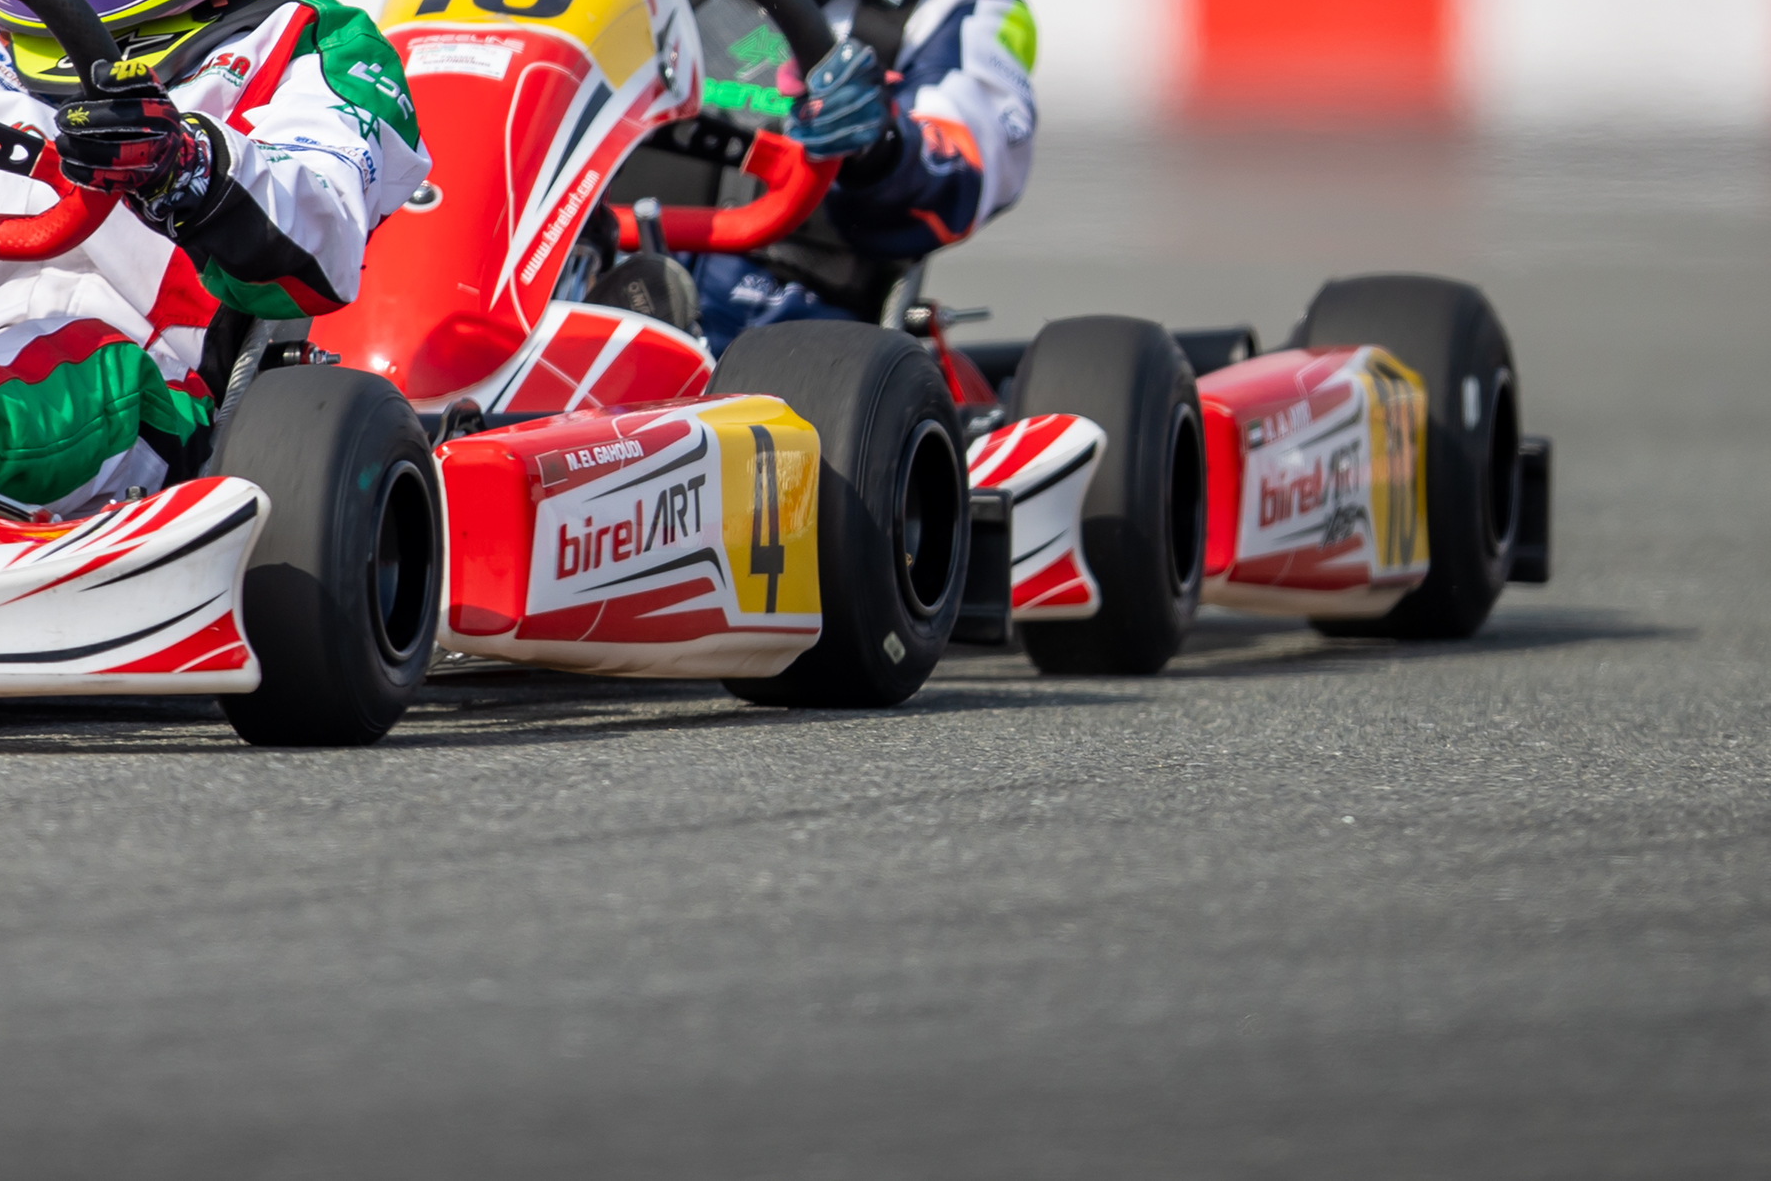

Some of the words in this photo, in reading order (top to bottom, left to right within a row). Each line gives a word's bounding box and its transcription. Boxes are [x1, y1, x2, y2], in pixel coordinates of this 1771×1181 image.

[565, 452, 582, 471] N.
[578, 450, 596, 468] EL
[593, 439, 644, 464] GAHOUDI
[556, 473, 706, 580] birelART
[750, 425, 785, 614] 4
